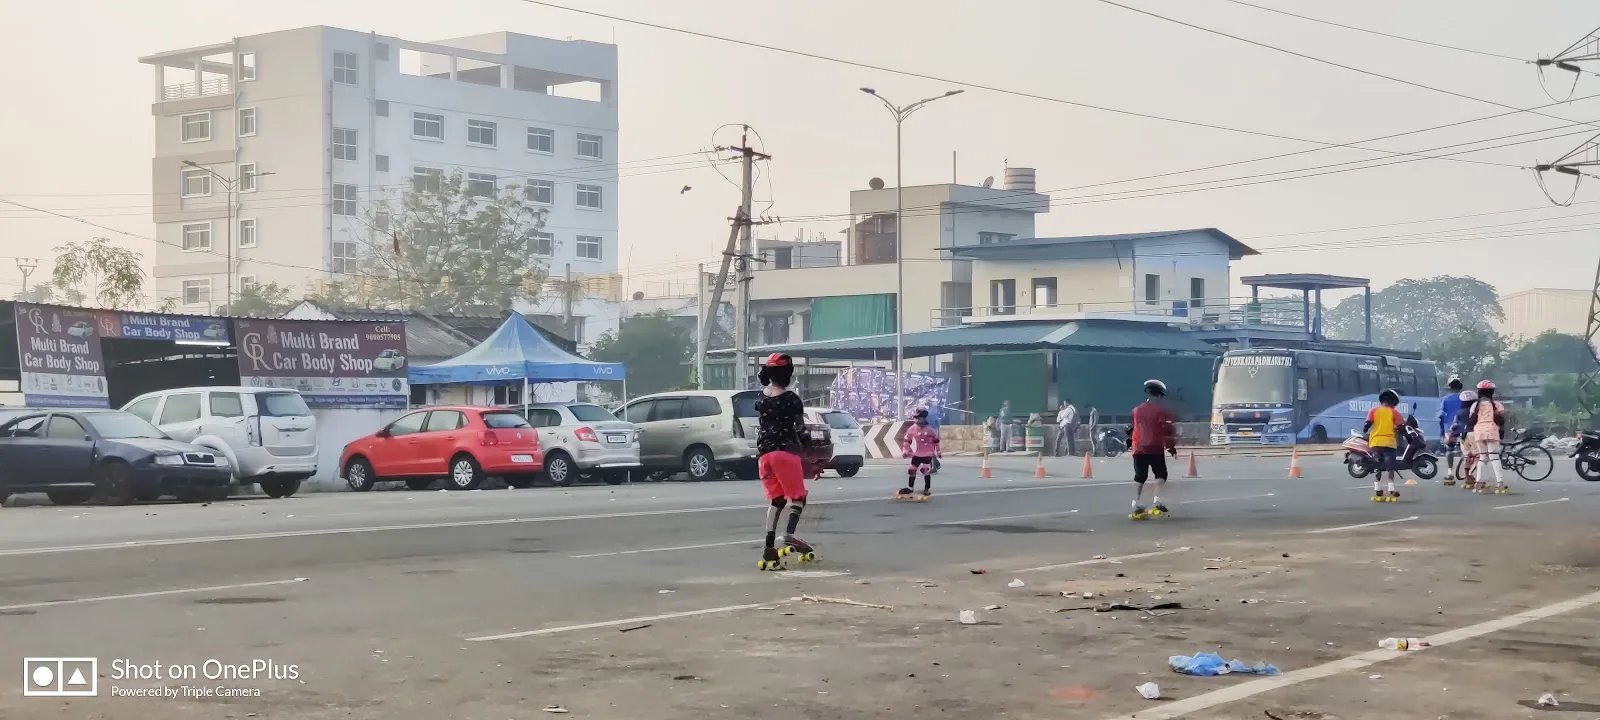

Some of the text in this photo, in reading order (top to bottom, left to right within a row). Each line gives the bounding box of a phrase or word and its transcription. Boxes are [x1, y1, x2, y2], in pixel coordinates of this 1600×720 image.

[129, 315, 190, 328] Multi Brand
[122, 326, 200, 340] Car Body Shop
[281, 331, 359, 350] Multi Brand
[31, 336, 89, 354] Multi Brand
[25, 352, 99, 373] Car Body Shop
[273, 352, 373, 374] Car Body Shop
